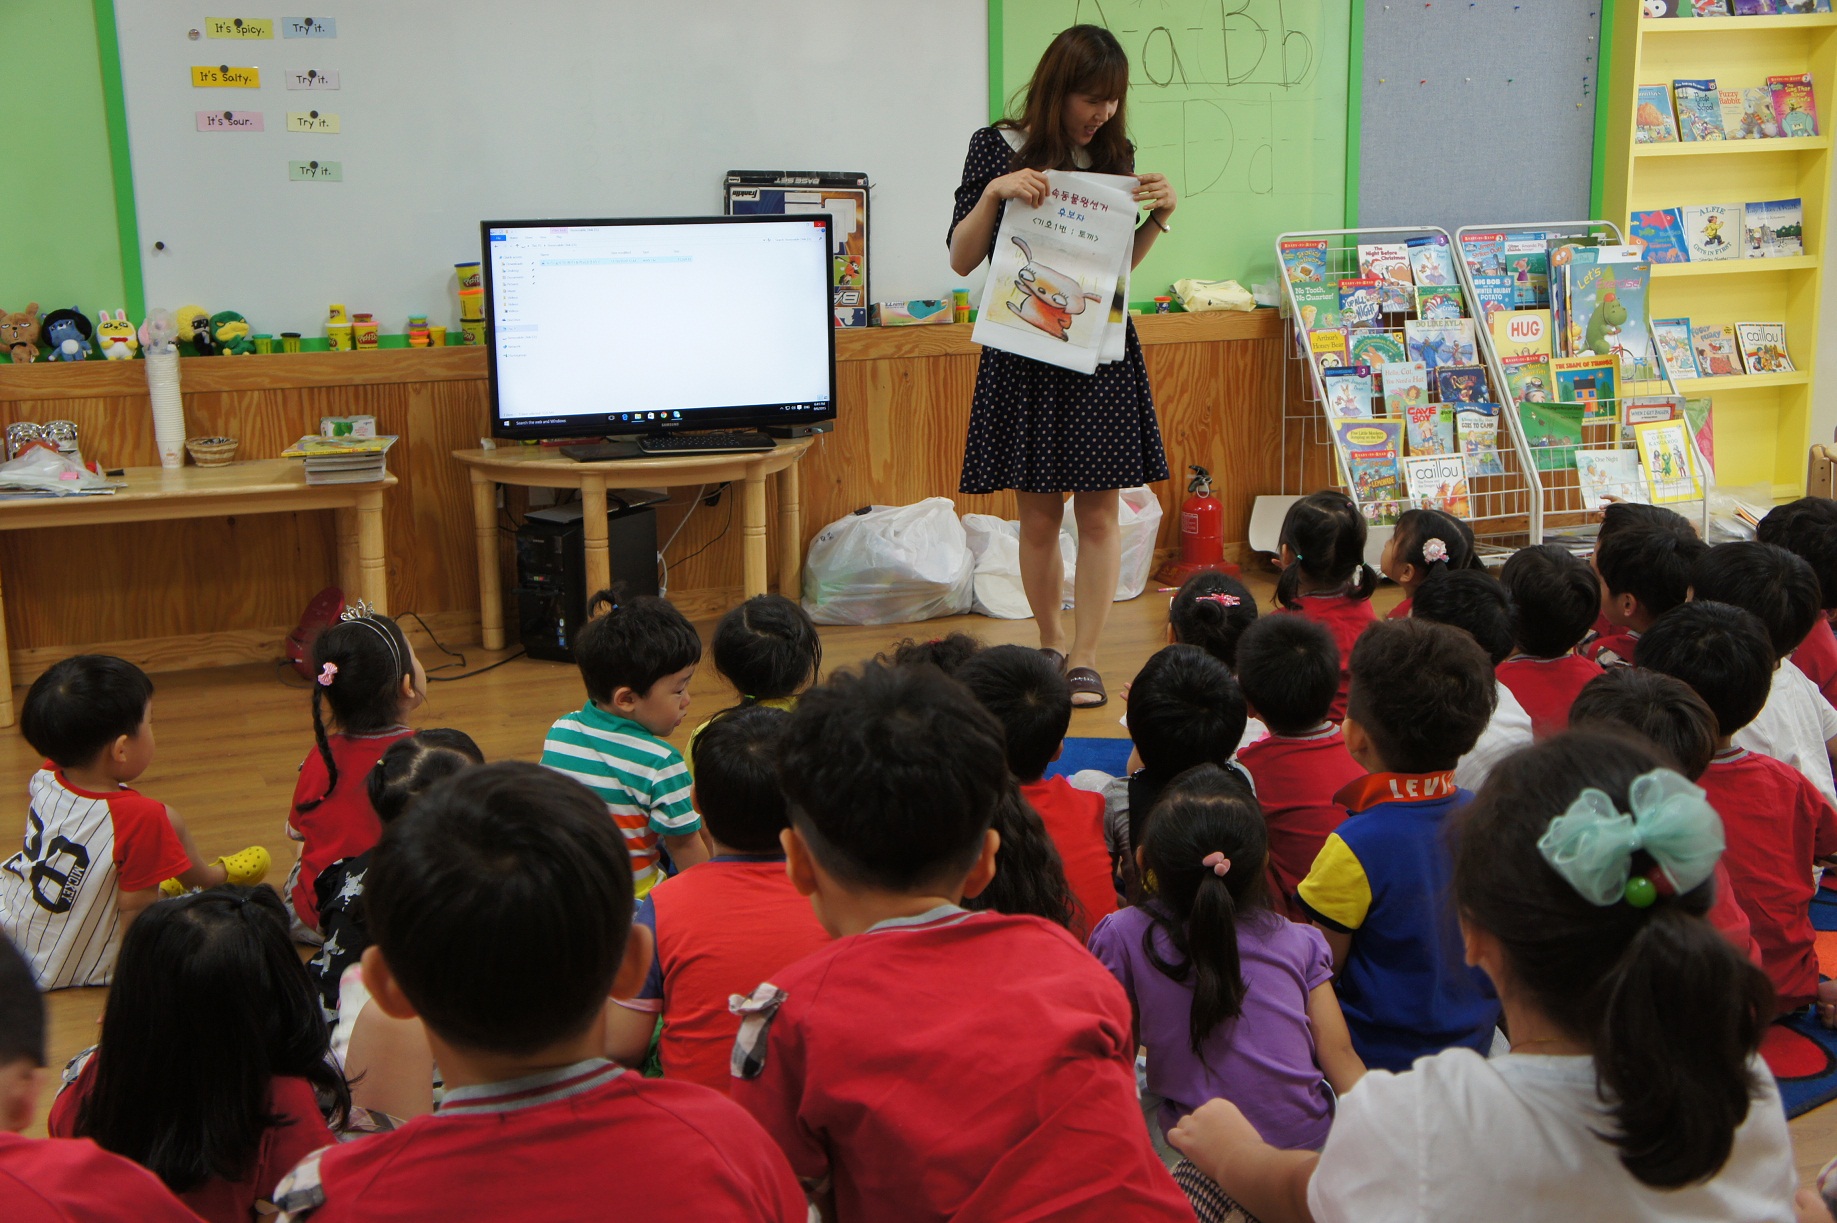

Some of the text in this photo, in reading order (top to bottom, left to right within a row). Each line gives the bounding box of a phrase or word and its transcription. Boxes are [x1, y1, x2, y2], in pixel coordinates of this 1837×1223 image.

[215, 22, 231, 34] It's
[293, 24, 325, 35] Try it.
[200, 71, 217, 82] It's
[296, 75, 328, 86] Try it.
[1697, 102, 1714, 112] School
[208, 116, 223, 126] It's
[298, 118, 329, 129] Try it.
[300, 166, 331, 178] Try it.
[732, 190, 758, 199] Franklin
[1058, 207, 1085, 222] 후보자
[1698, 206, 1726, 216] ALFIE
[1694, 244, 1707, 254] GETS
[1715, 242, 1732, 255] FIRST
[1577, 268, 1601, 290] Let's
[1596, 277, 1642, 290] Exercise!
[1306, 293, 1334, 301] Quarter!
[1356, 303, 1375, 320] NIGHT
[1511, 321, 1540, 337] HUG
[1746, 327, 1778, 342] caillou
[1591, 359, 1613, 367] THINGS
[1408, 406, 1436, 415] CAVE
[1412, 415, 1431, 424] BOY
[1416, 460, 1458, 479] caillou
[1372, 476, 1395, 488] LEMONADE
[60, 864, 85, 905] MICKEY
